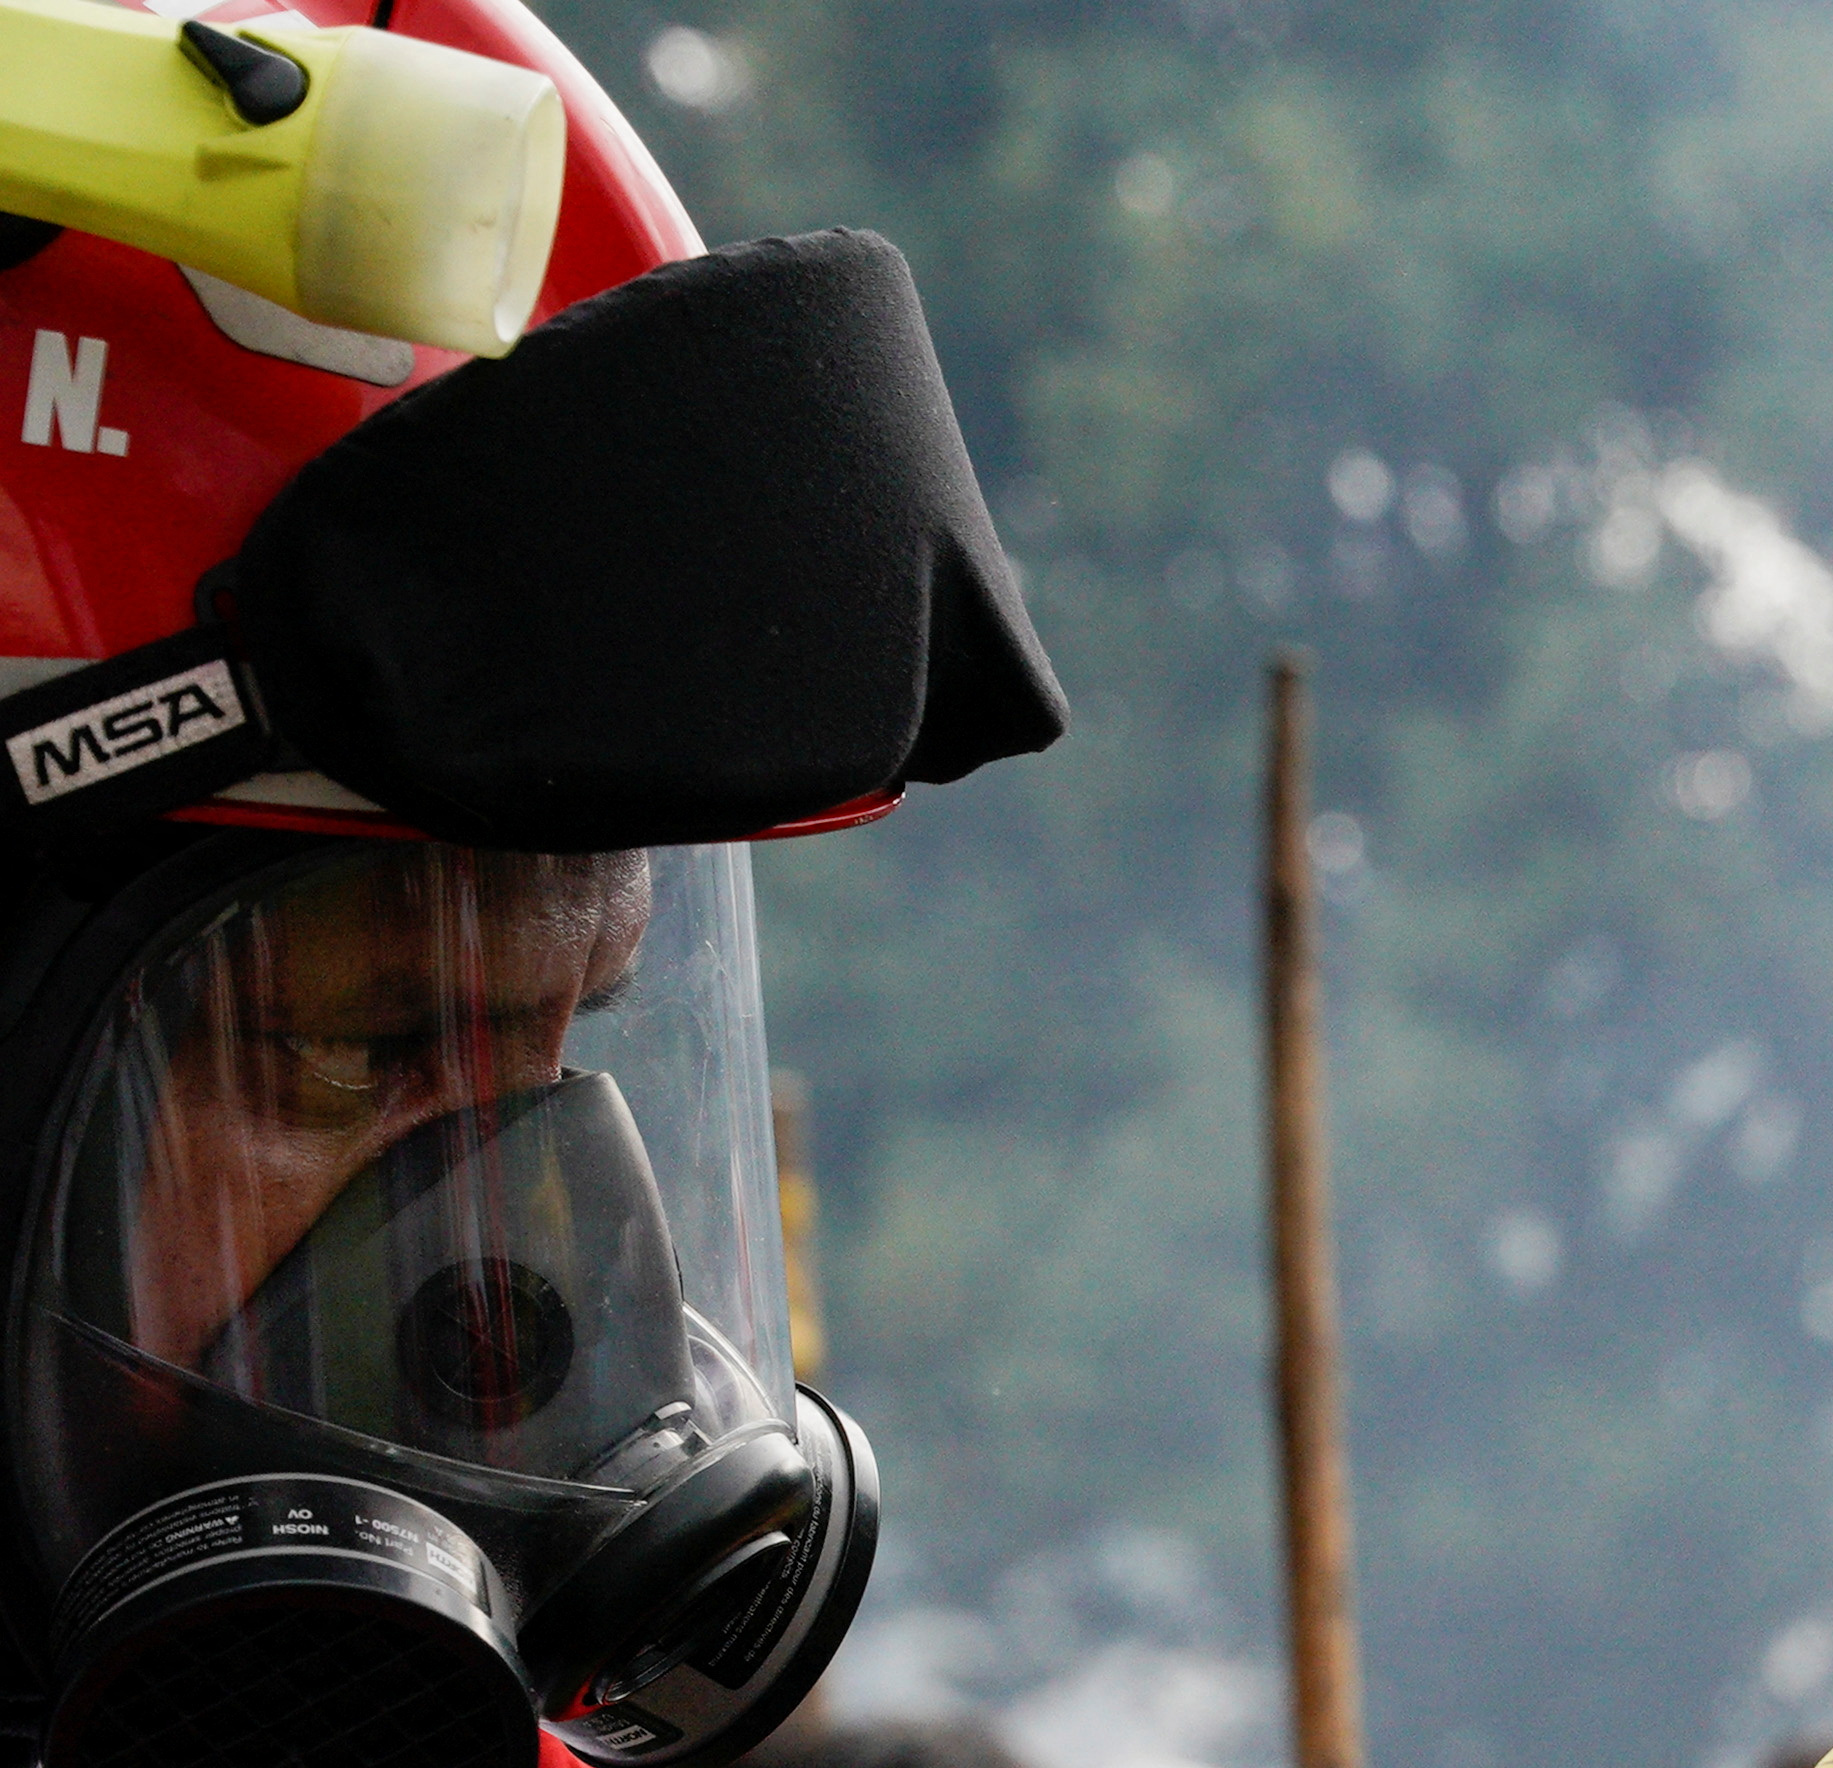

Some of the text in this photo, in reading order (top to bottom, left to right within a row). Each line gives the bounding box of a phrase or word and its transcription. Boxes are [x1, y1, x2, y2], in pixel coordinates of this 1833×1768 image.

[21, 328, 129, 457] N.
[32, 683, 226, 787] MSA
[287, 1508, 313, 1519] OV
[165, 1518, 225, 1543] WARNING
[272, 1523, 330, 1535] NIOSH
